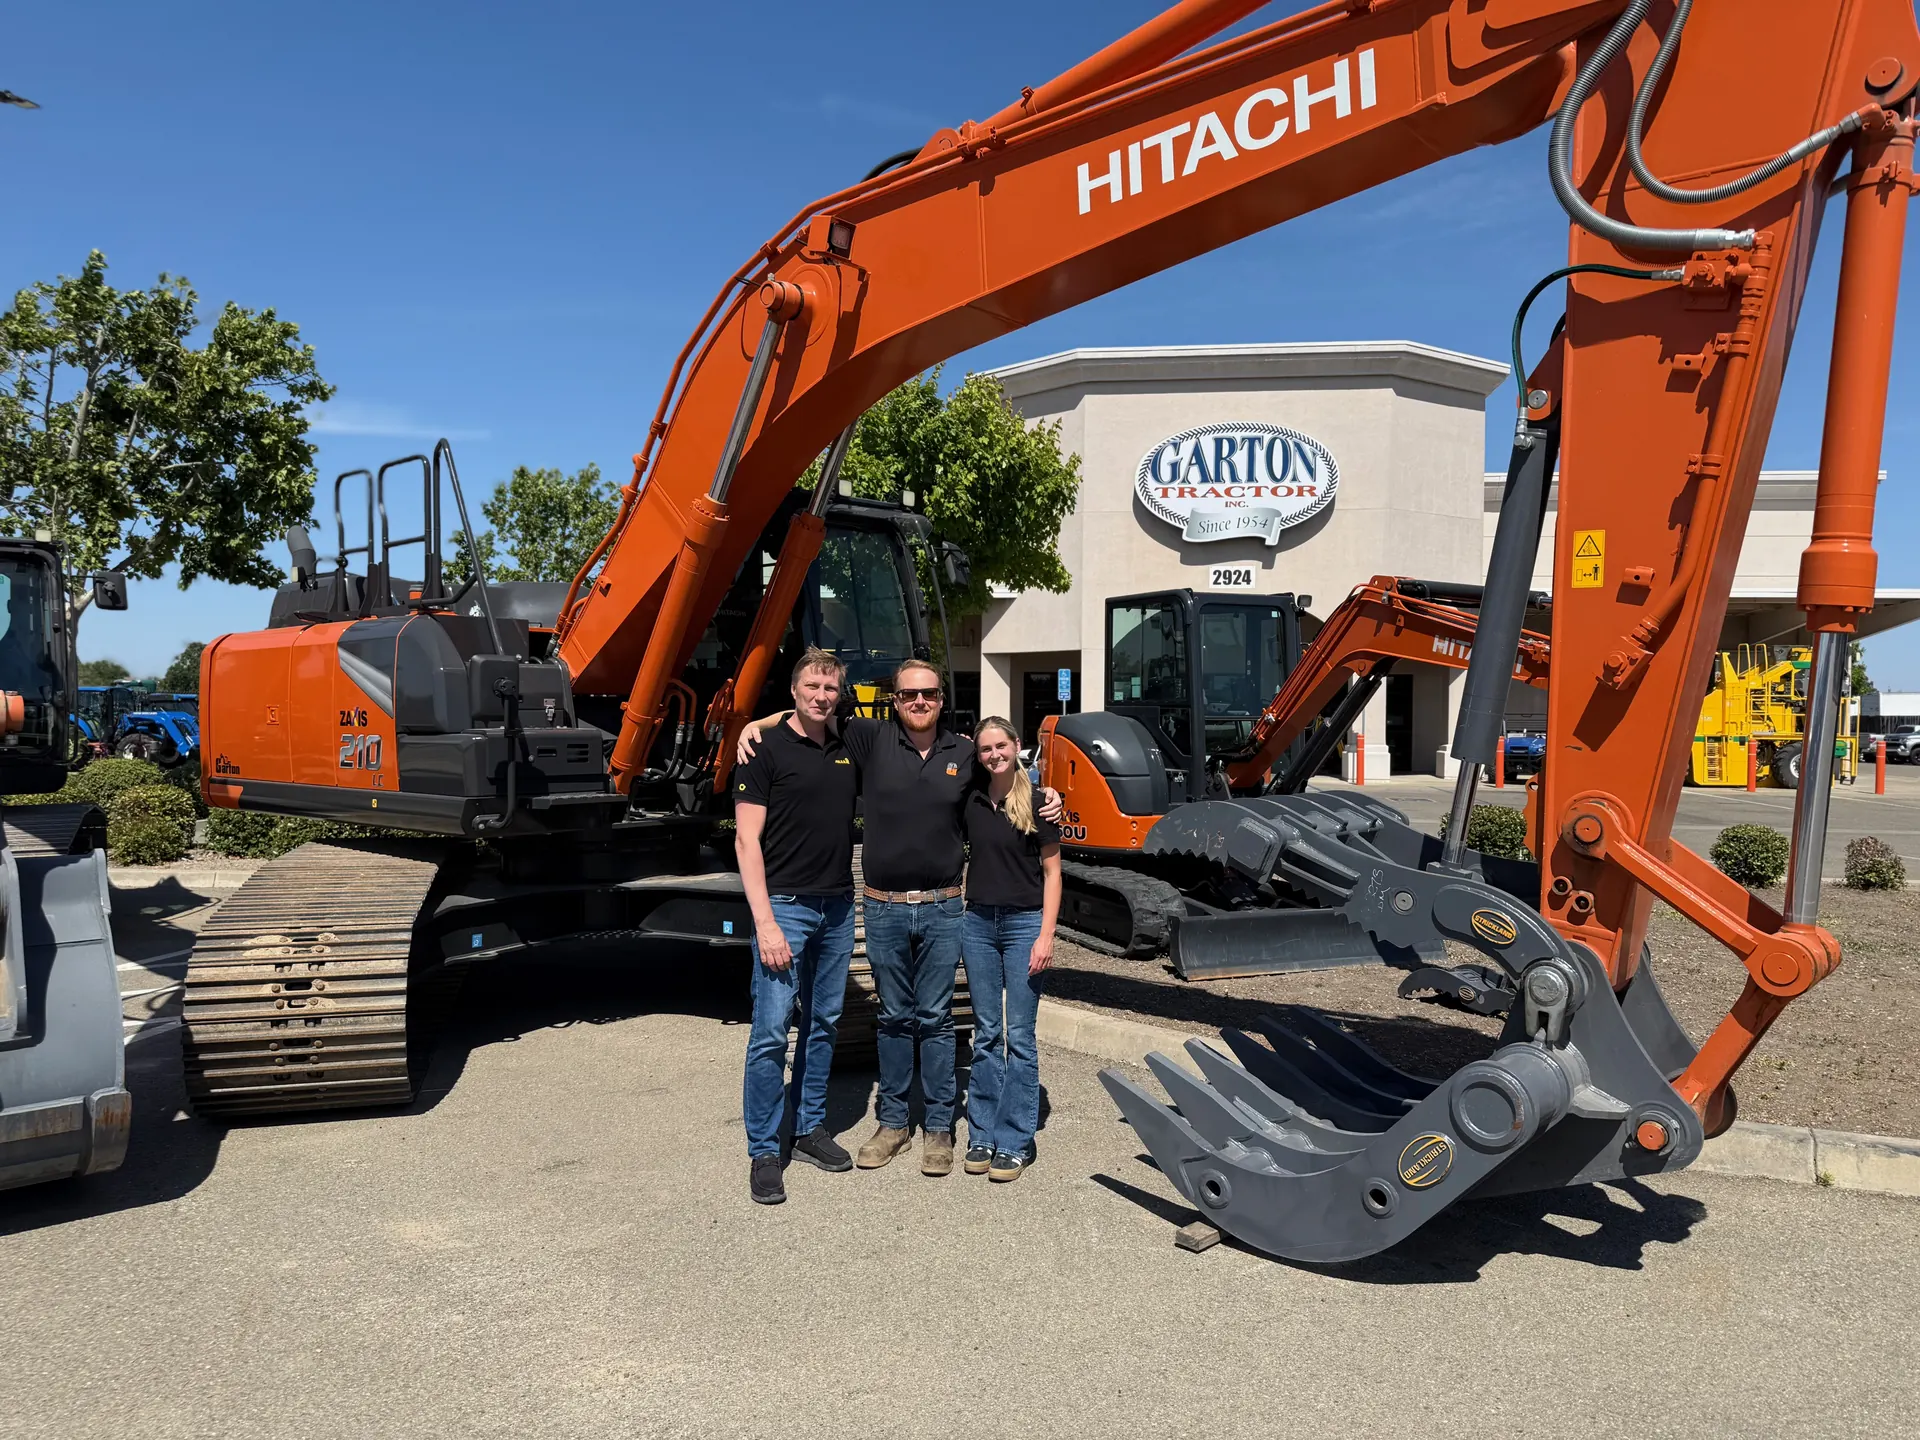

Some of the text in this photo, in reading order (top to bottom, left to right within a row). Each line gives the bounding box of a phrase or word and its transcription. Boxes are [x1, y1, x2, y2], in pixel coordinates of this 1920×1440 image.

[1077, 47, 1377, 216] HITACHI
[1150, 435, 1321, 485] GARTON
[1154, 485, 1319, 498] TRACTOR
[1224, 500, 1249, 508] INC.
[1197, 515, 1269, 534] Since 1954
[1212, 569, 1252, 586] 2924
[339, 707, 368, 727] ZAXIS
[338, 733, 383, 771] 210
[215, 757, 240, 775] Garton
[1474, 915, 1513, 939] STRICKLAND
[1403, 1142, 1447, 1179] STRICKLAND
